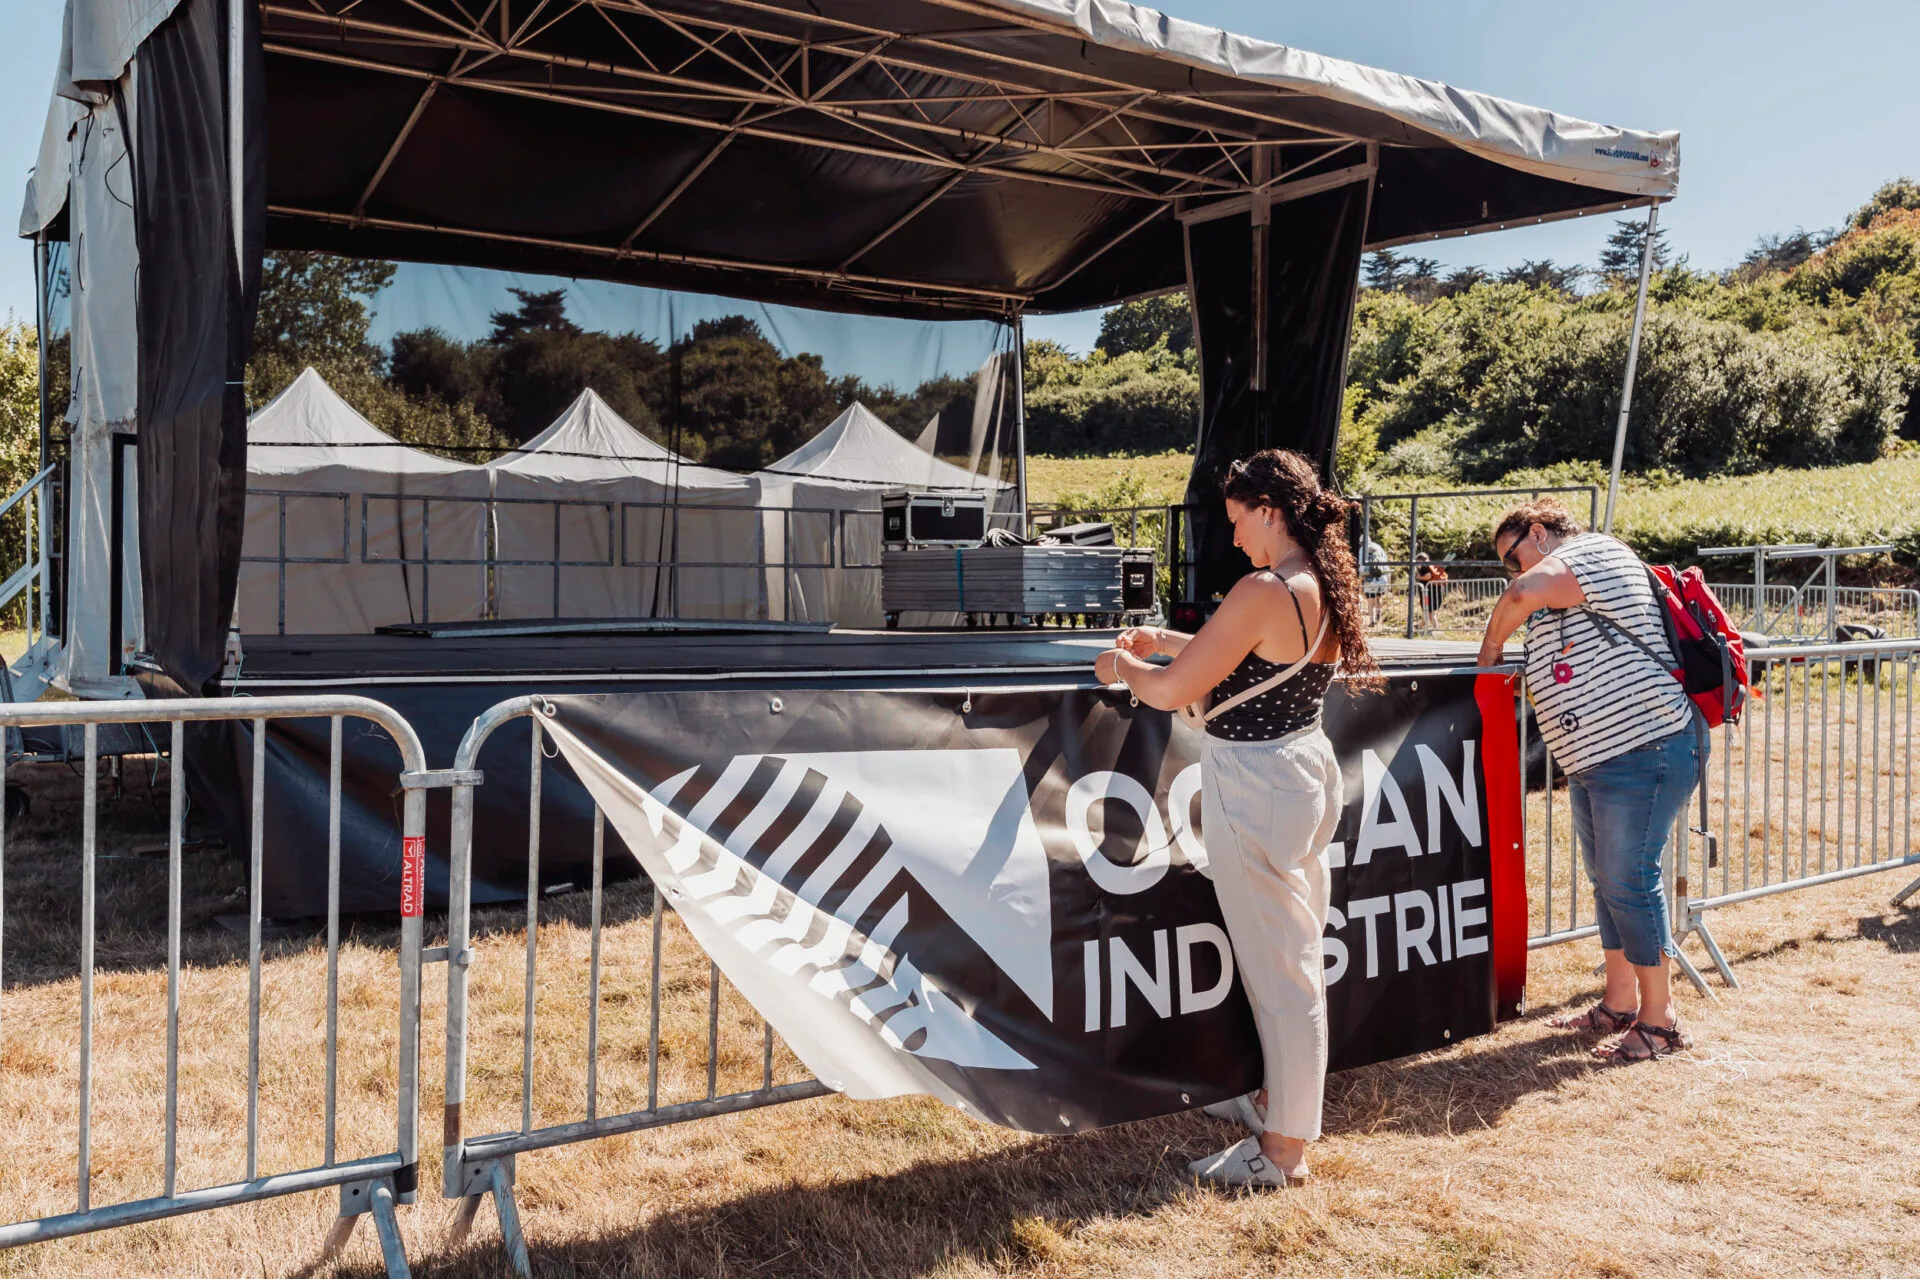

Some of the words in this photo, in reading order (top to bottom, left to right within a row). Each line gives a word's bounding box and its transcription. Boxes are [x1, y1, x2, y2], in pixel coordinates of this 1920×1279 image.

[403, 859, 413, 913] ALTRAD
[1065, 740, 1482, 895] OAN
[1083, 878, 1489, 1033] INDSTRIE
